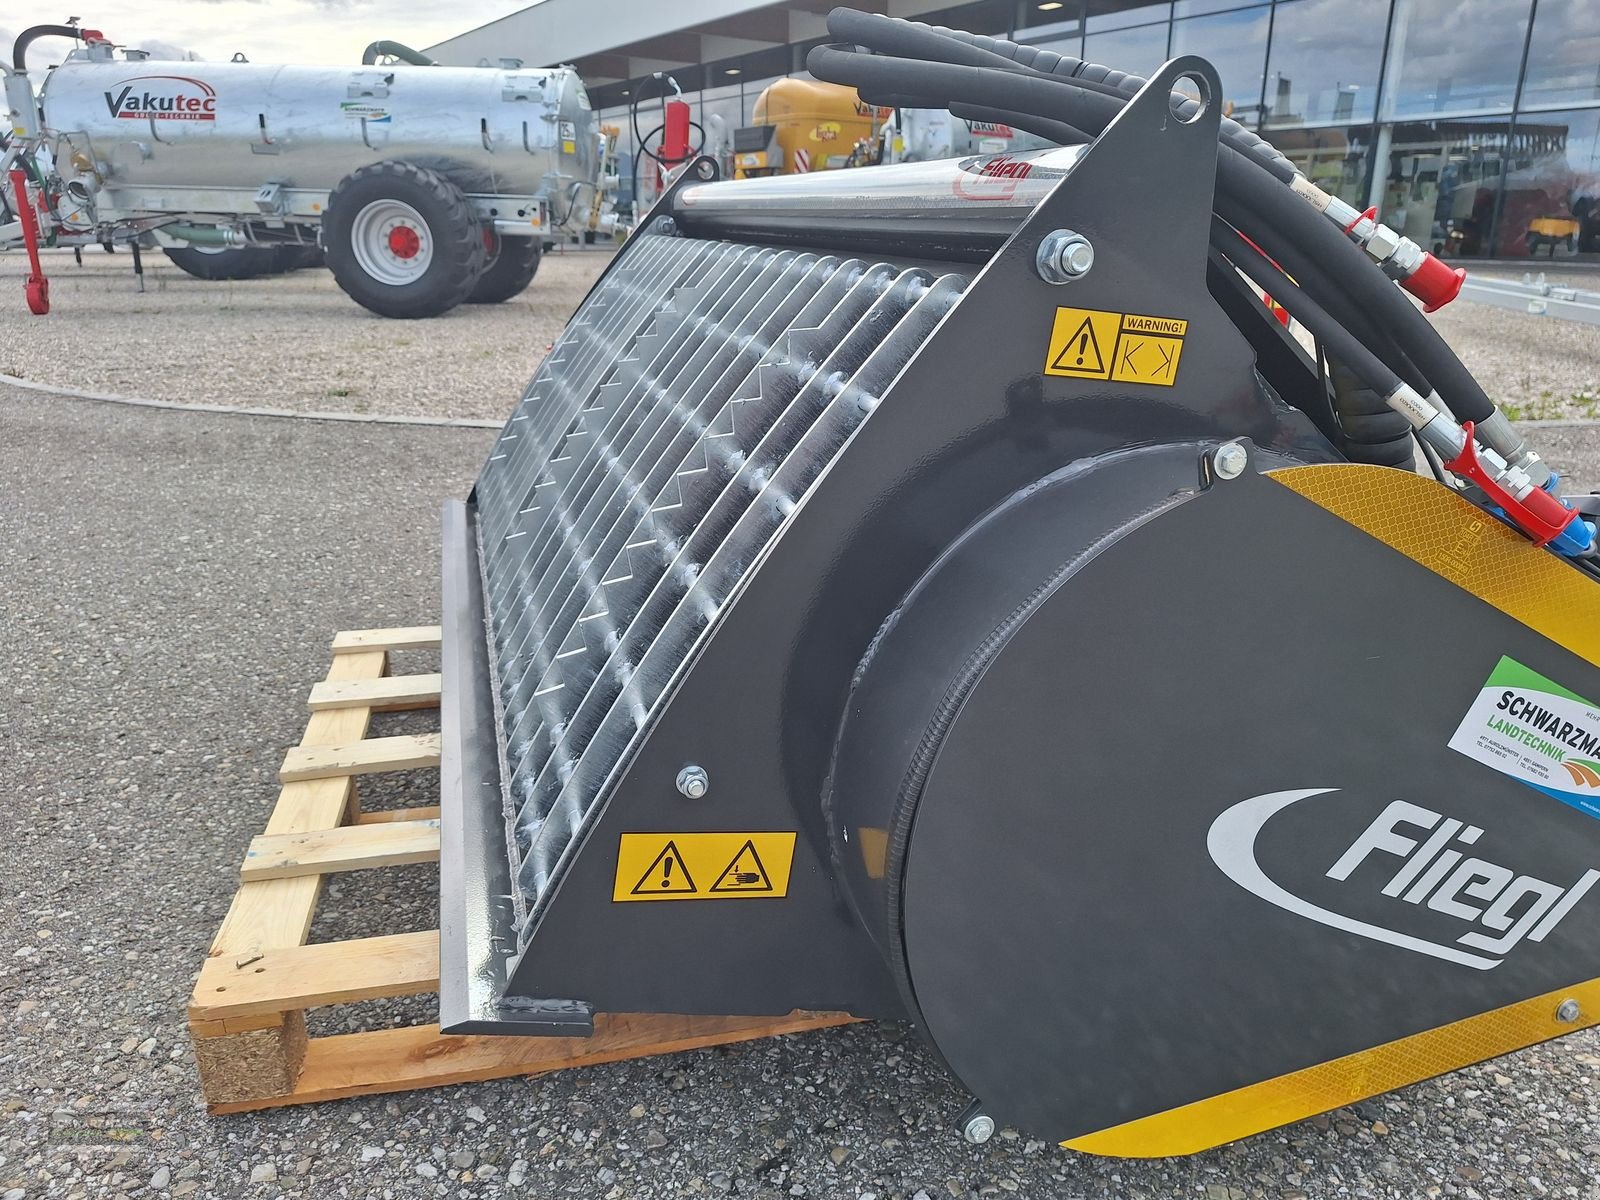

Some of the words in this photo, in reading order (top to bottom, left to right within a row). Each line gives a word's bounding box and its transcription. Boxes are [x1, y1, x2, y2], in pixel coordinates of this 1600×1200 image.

[104, 86, 216, 119] Vakutec
[1127, 317, 1183, 333] WARNING!
[1487, 714, 1566, 762] LANDTECHNIK
[1325, 799, 1600, 955] Fliegl
